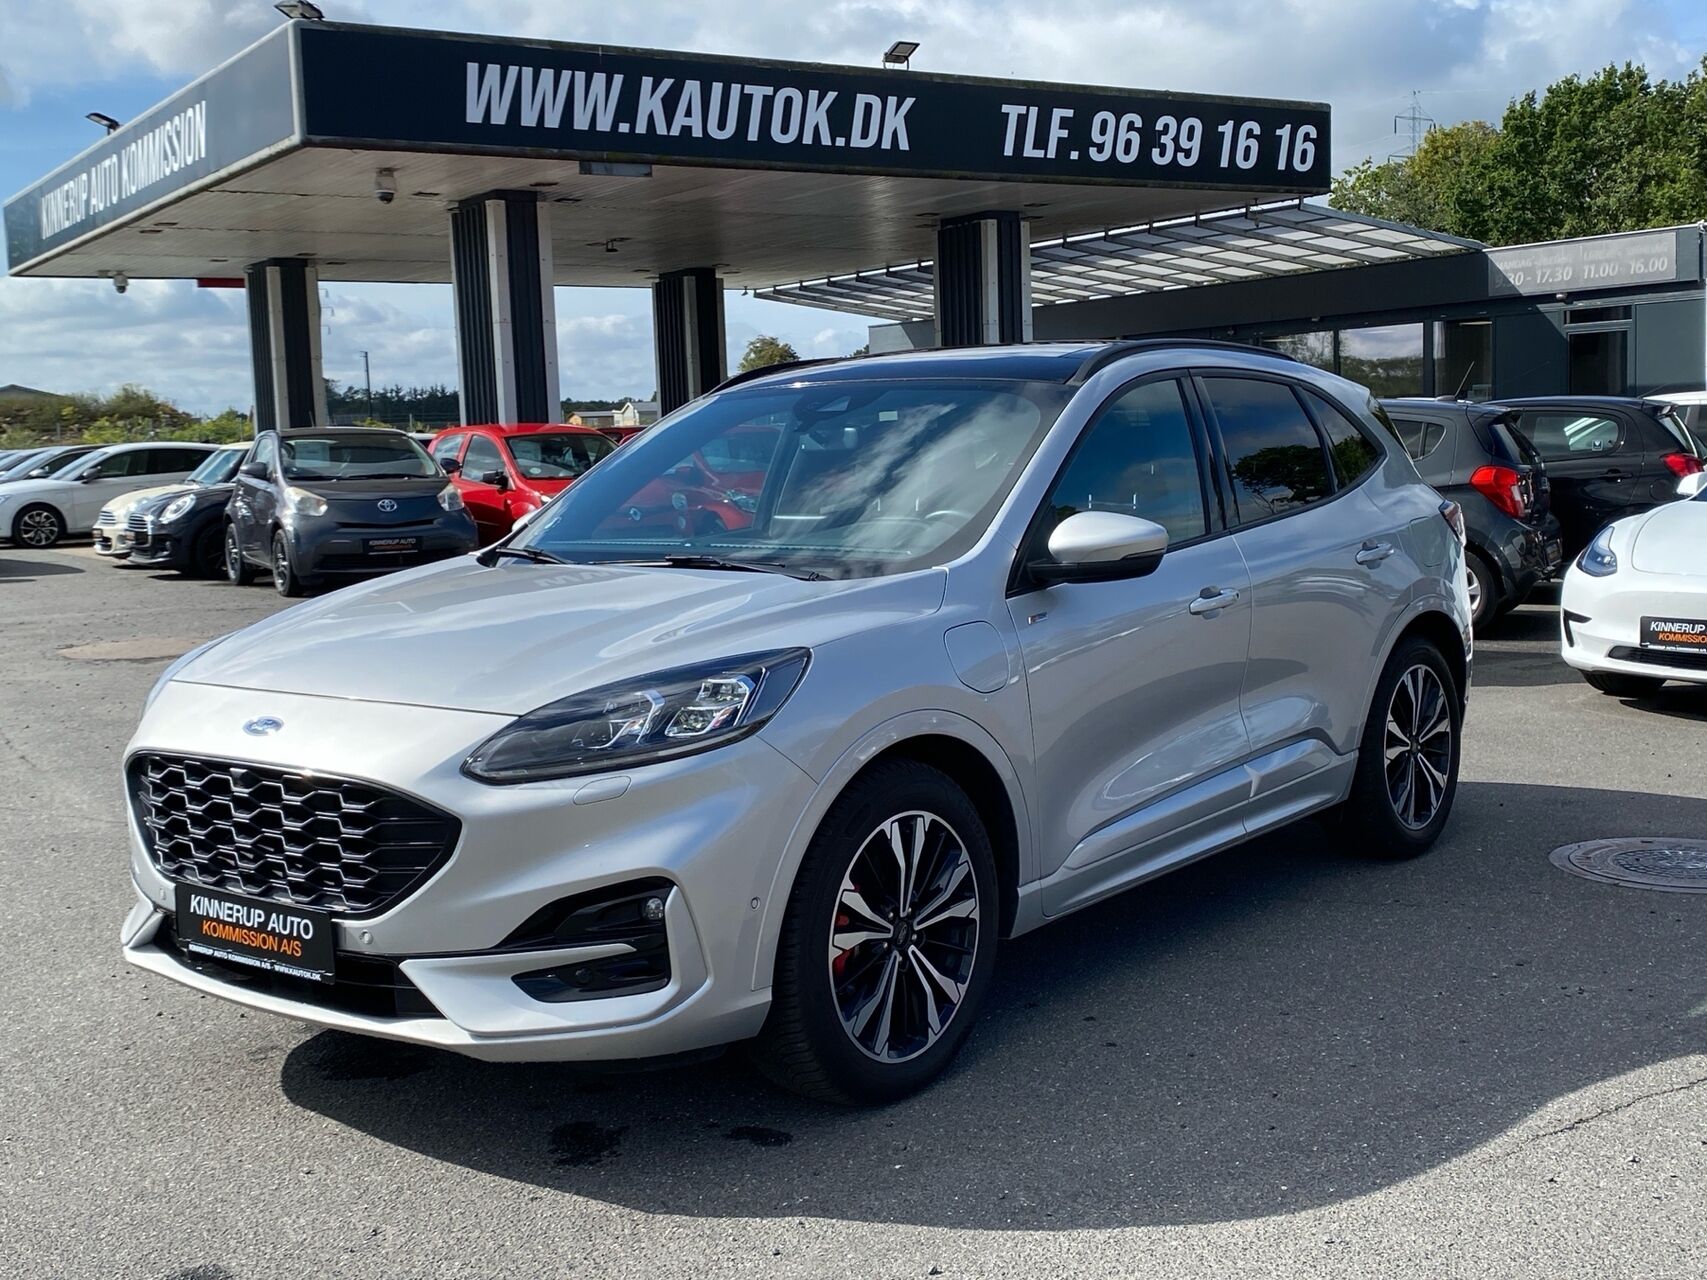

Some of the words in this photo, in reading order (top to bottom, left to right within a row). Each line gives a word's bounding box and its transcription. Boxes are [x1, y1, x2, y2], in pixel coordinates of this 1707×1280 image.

[465, 62, 917, 152] WWW.KAUTOK.DK
[1001, 104, 1080, 161] TLF.
[1088, 110, 1143, 165] 96
[1151, 115, 1203, 168] 39
[1217, 120, 1261, 170] 16
[1275, 124, 1317, 173] 16
[41, 172, 88, 240] KINNERUP
[90, 153, 119, 215] AUTO
[121, 100, 207, 199] KOMMISSION
[1536, 266, 1573, 284] 17.30
[1630, 256, 1668, 274] 16.00
[1650, 621, 1706, 634] KINNERUP
[190, 894, 265, 928] KINNERUP
[268, 912, 313, 940] AUTO
[202, 920, 279, 952] KOMMISSION
[280, 937, 302, 957] A/S
